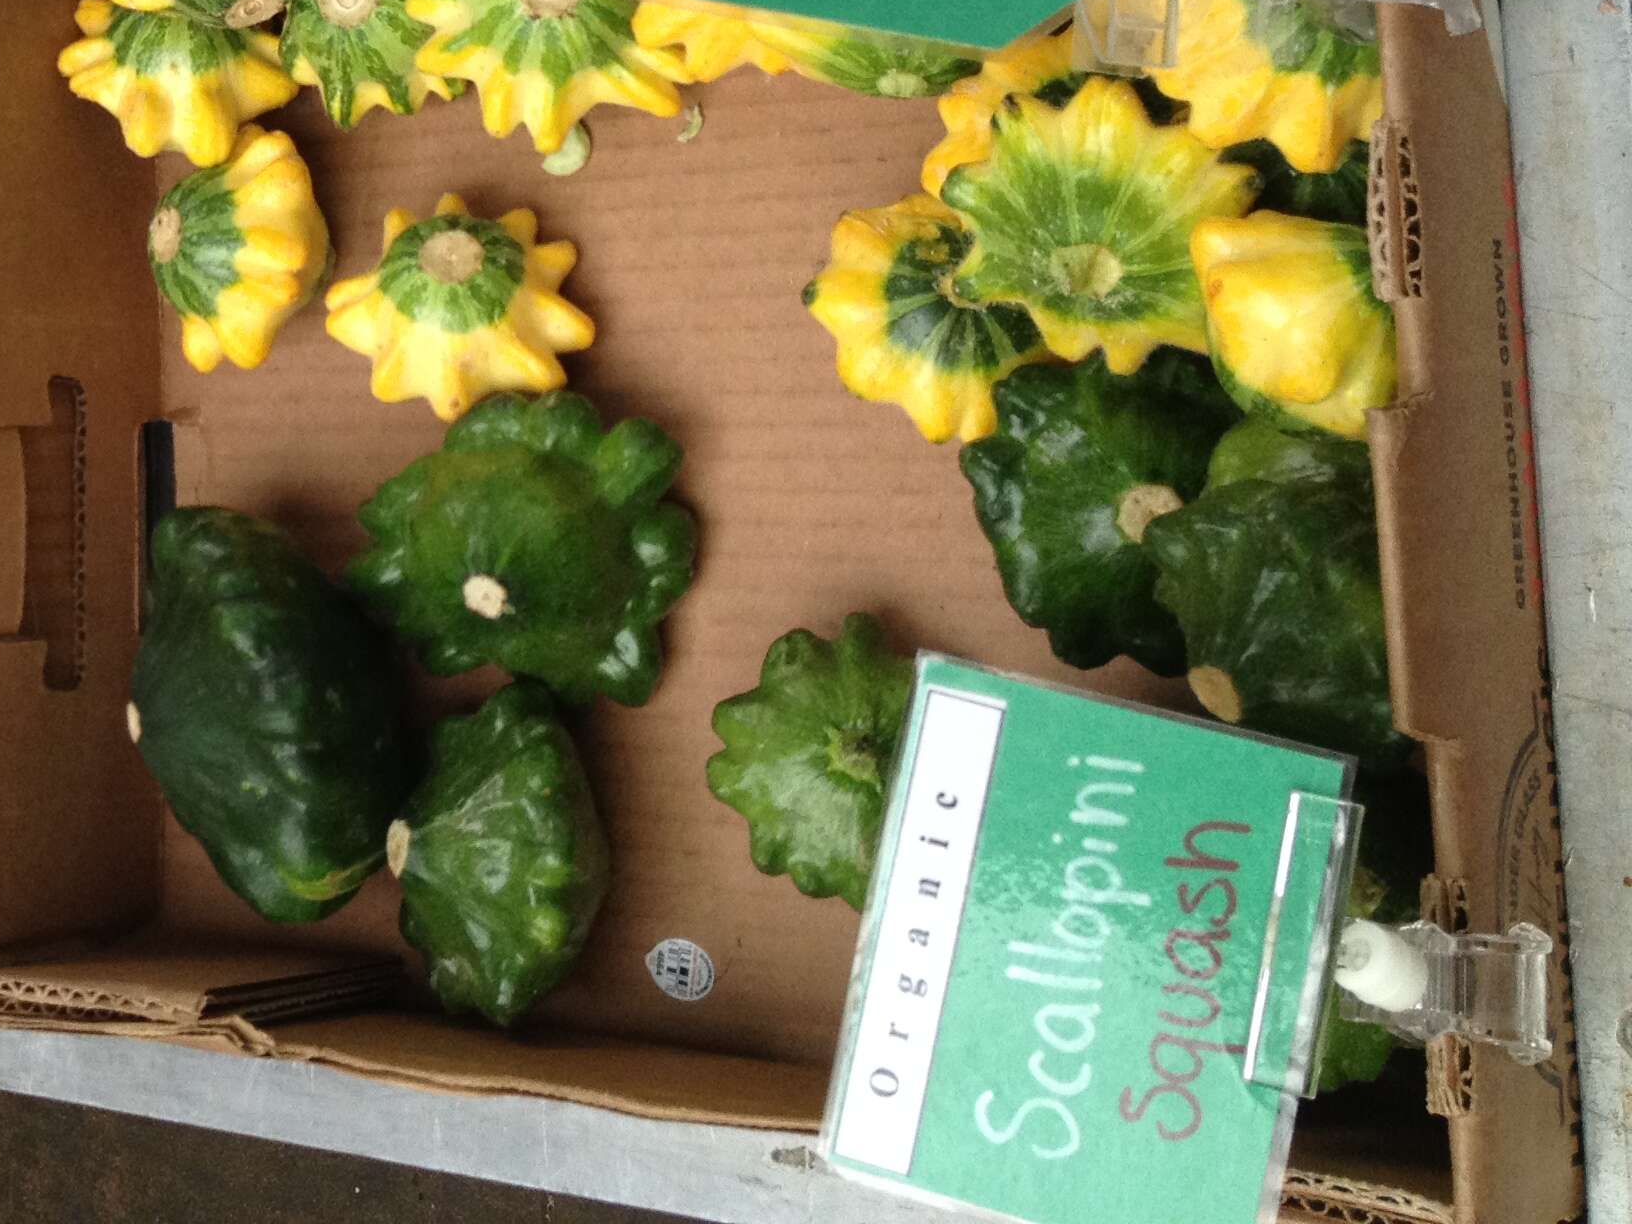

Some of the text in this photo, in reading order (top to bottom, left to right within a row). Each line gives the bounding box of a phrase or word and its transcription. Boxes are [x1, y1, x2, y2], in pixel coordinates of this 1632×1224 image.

[1492, 238, 1526, 610] GREENHOUSE GROWN
[868, 789, 959, 1099] Organic
[973, 754, 1152, 1160] Scallopini
[1118, 818, 1252, 1142] Squash
